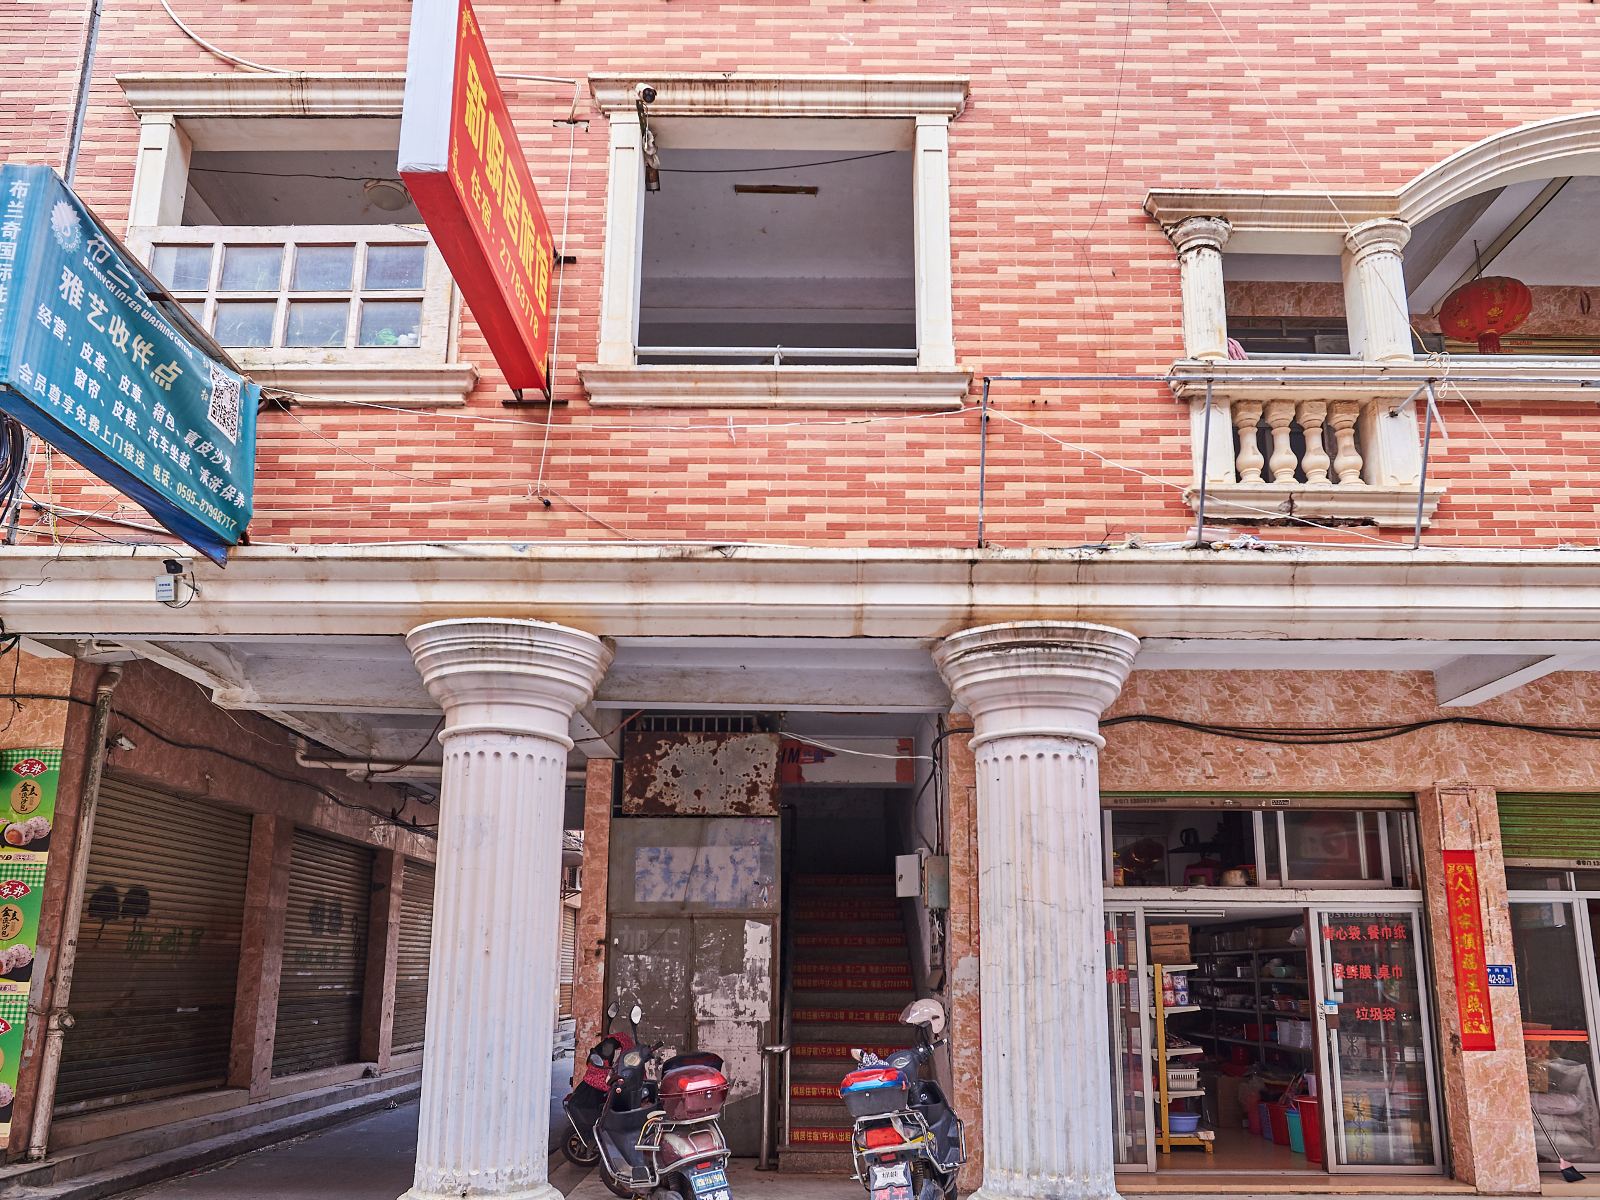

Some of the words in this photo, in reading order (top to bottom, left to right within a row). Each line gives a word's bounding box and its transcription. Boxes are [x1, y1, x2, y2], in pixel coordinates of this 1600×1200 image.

[58, 265, 184, 392] 雅艺收件点
[140, 308, 175, 340] WASHING
[1356, 1006, 1396, 1021] 垃圾袋
